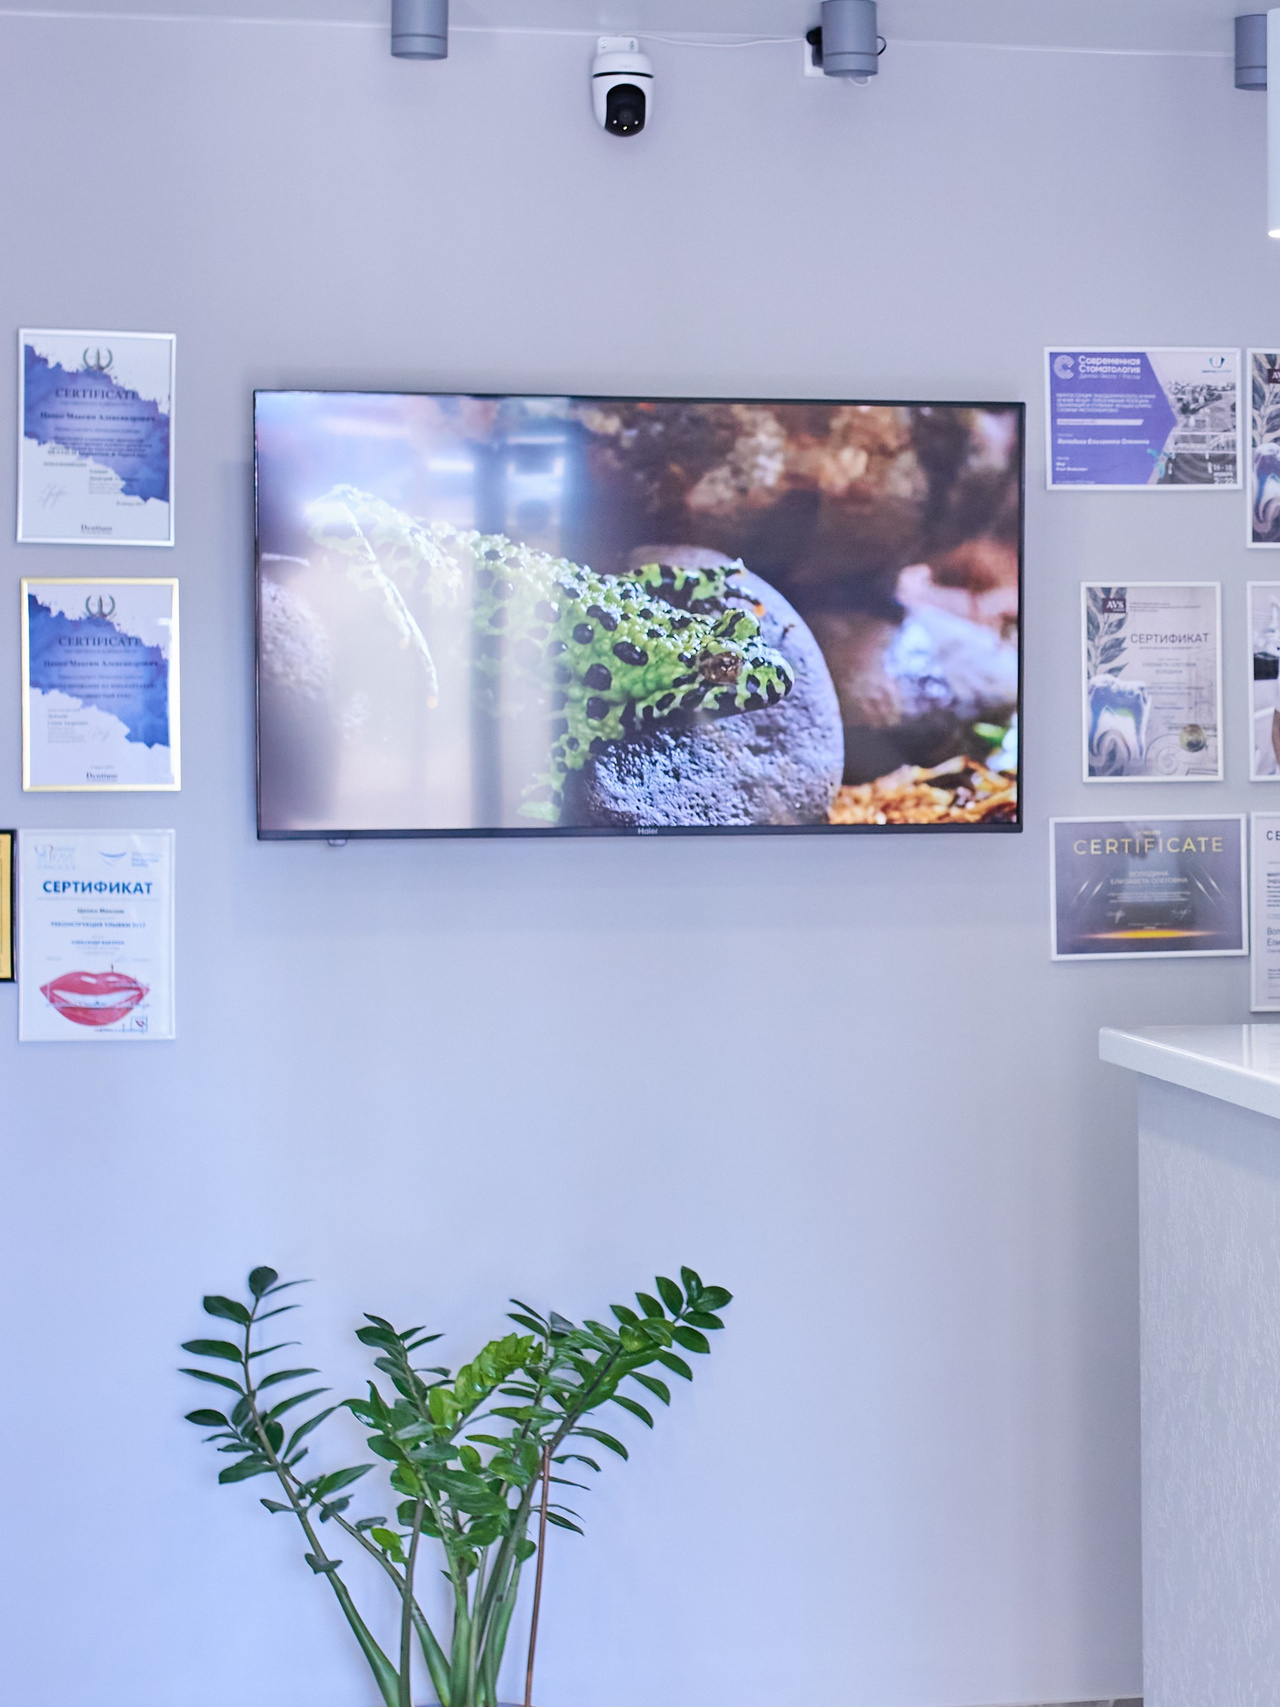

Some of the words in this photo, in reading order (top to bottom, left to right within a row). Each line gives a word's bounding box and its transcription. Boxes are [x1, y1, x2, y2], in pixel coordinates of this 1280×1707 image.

[1078, 355, 1141, 367] Современная
[1078, 365, 1141, 374] Стоматология
[55, 388, 138, 400] CERTIFICATE
[1106, 601, 1125, 609] AVS
[58, 637, 140, 647] CERTIFICATE
[1130, 633, 1209, 644] СЕРТИФИКАТ
[1073, 836, 1224, 855] CERTIFICATE
[42, 880, 153, 894] СЕРТИФИКАТ
